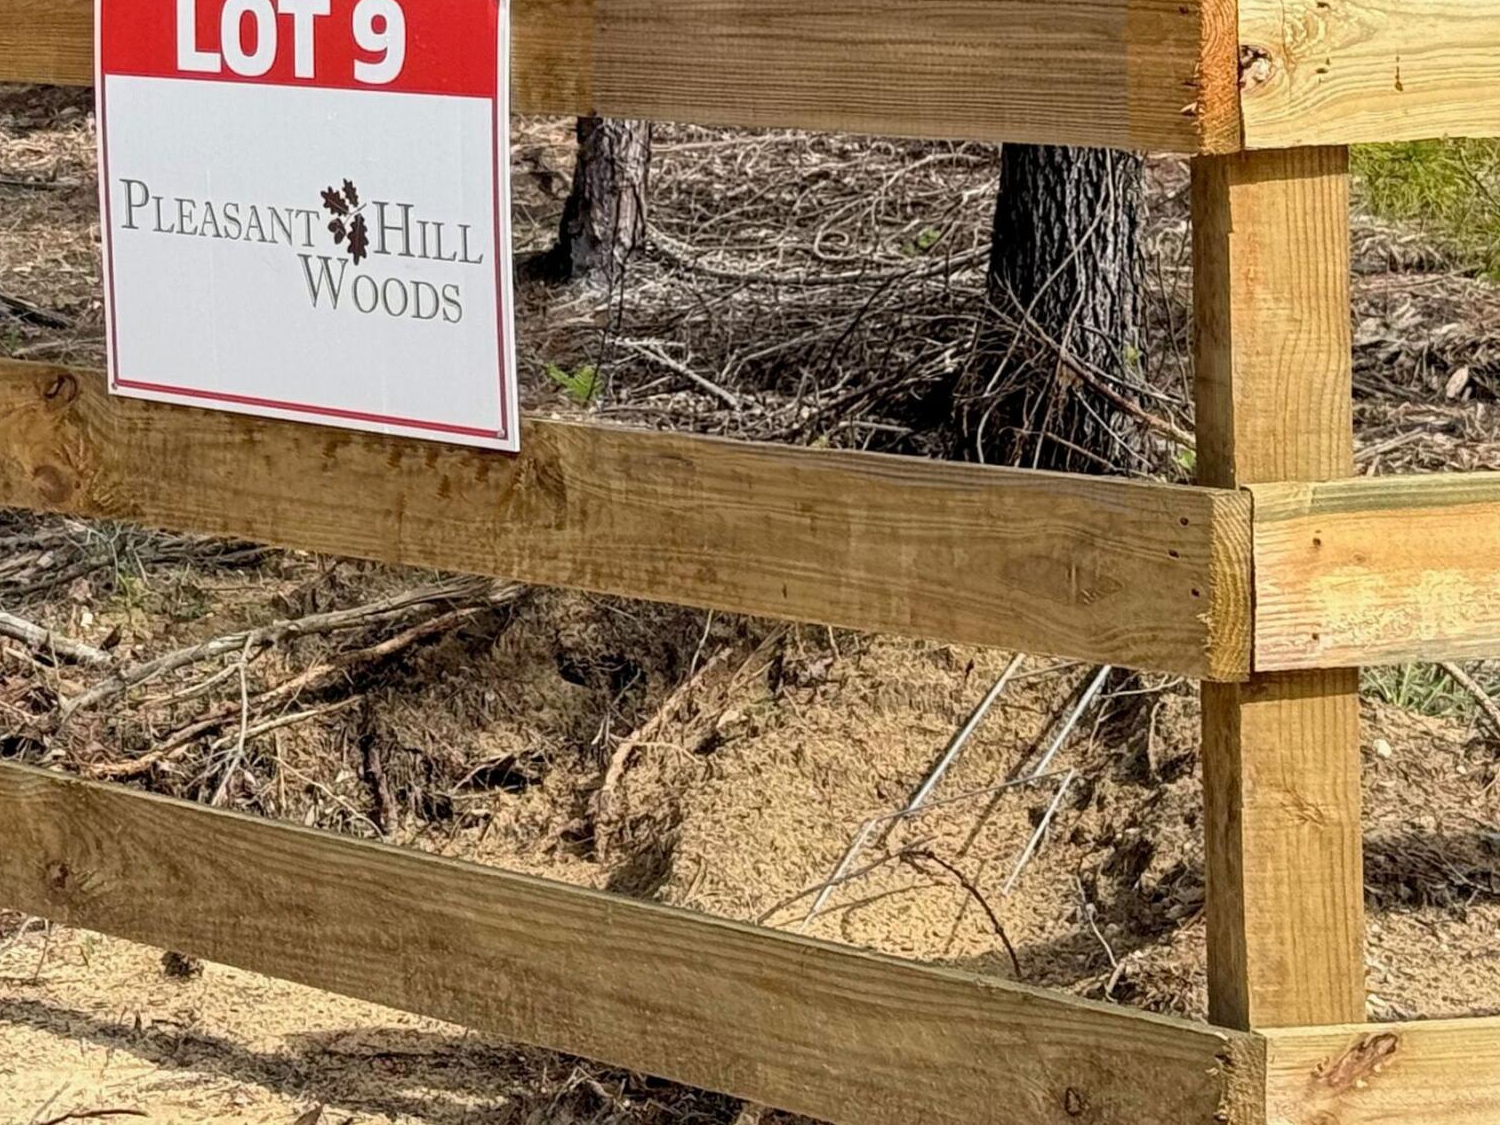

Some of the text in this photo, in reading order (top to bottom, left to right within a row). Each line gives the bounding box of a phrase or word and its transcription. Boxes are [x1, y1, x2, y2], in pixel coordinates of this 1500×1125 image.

[119, 178, 484, 264] PLEASANT HILL
[297, 253, 463, 323] WOODS
